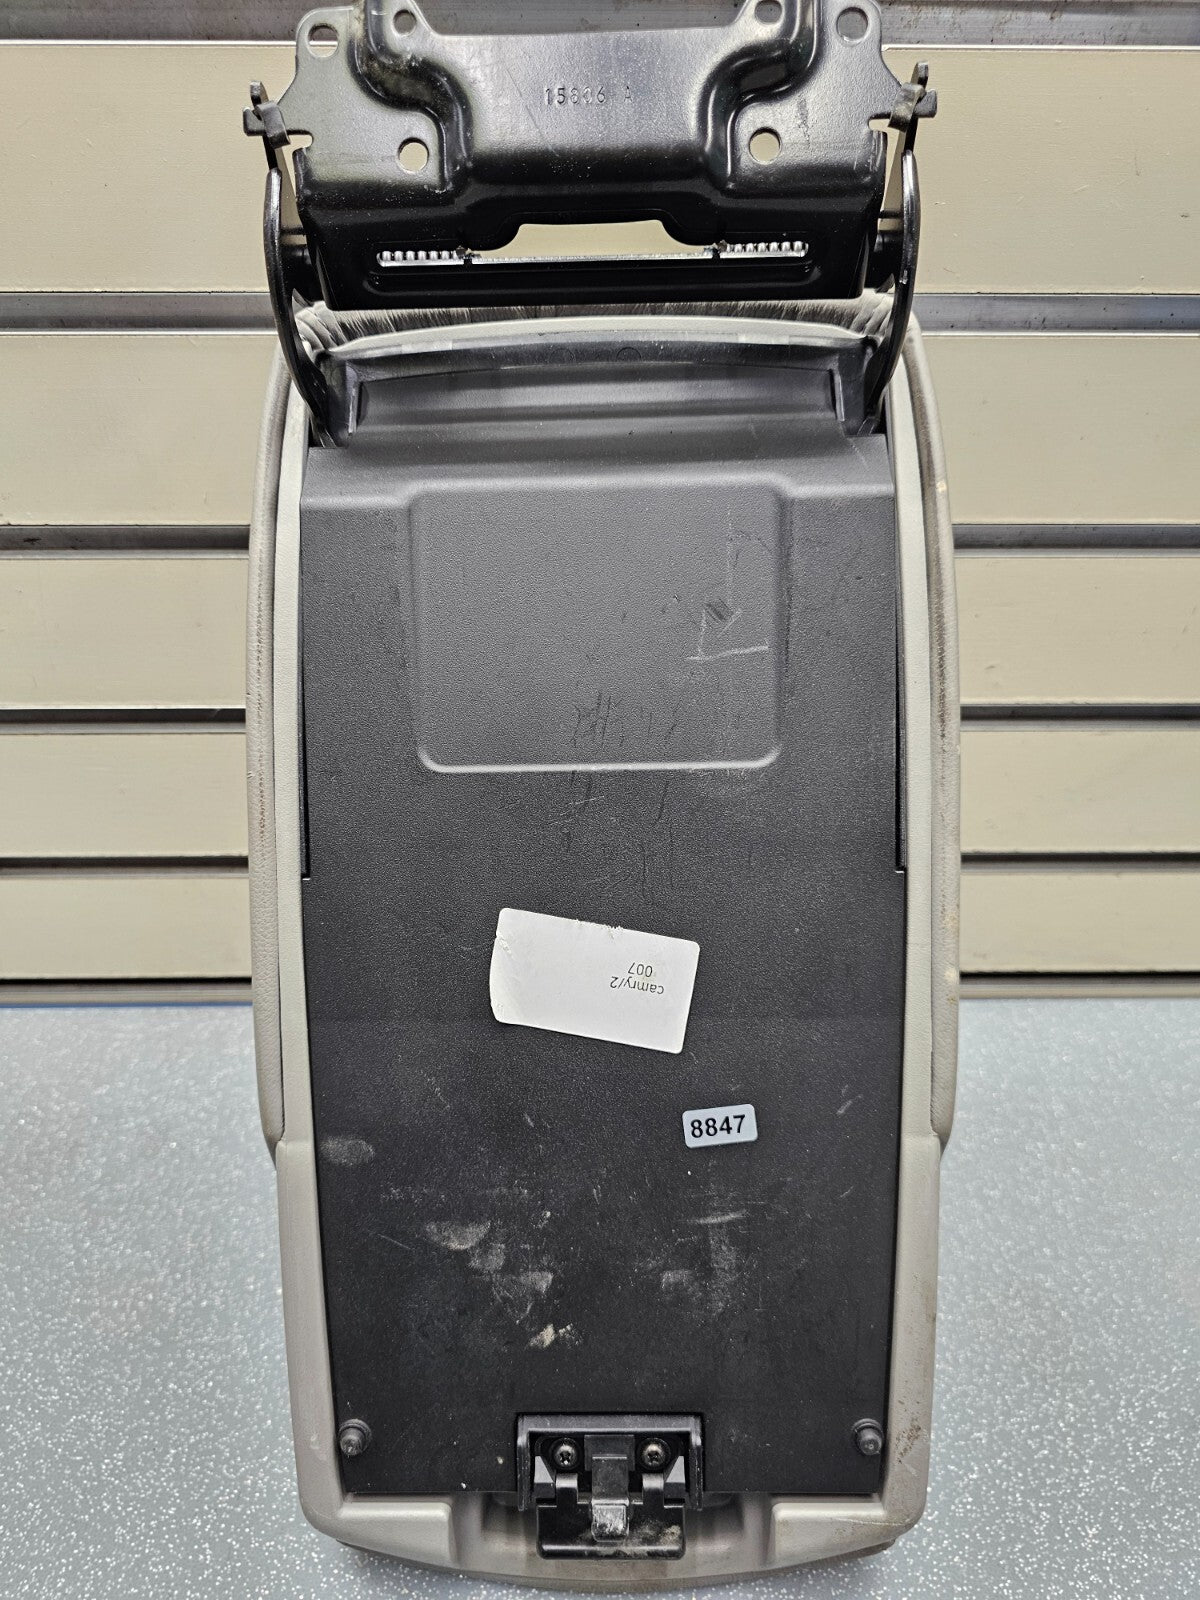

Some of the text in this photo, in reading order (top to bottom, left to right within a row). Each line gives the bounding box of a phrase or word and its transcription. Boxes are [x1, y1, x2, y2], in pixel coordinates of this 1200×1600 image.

[545, 86, 633, 105] 15806 A
[627, 962, 653, 978] 007
[610, 976, 664, 995] camry/2
[690, 1114, 746, 1139] 8847
